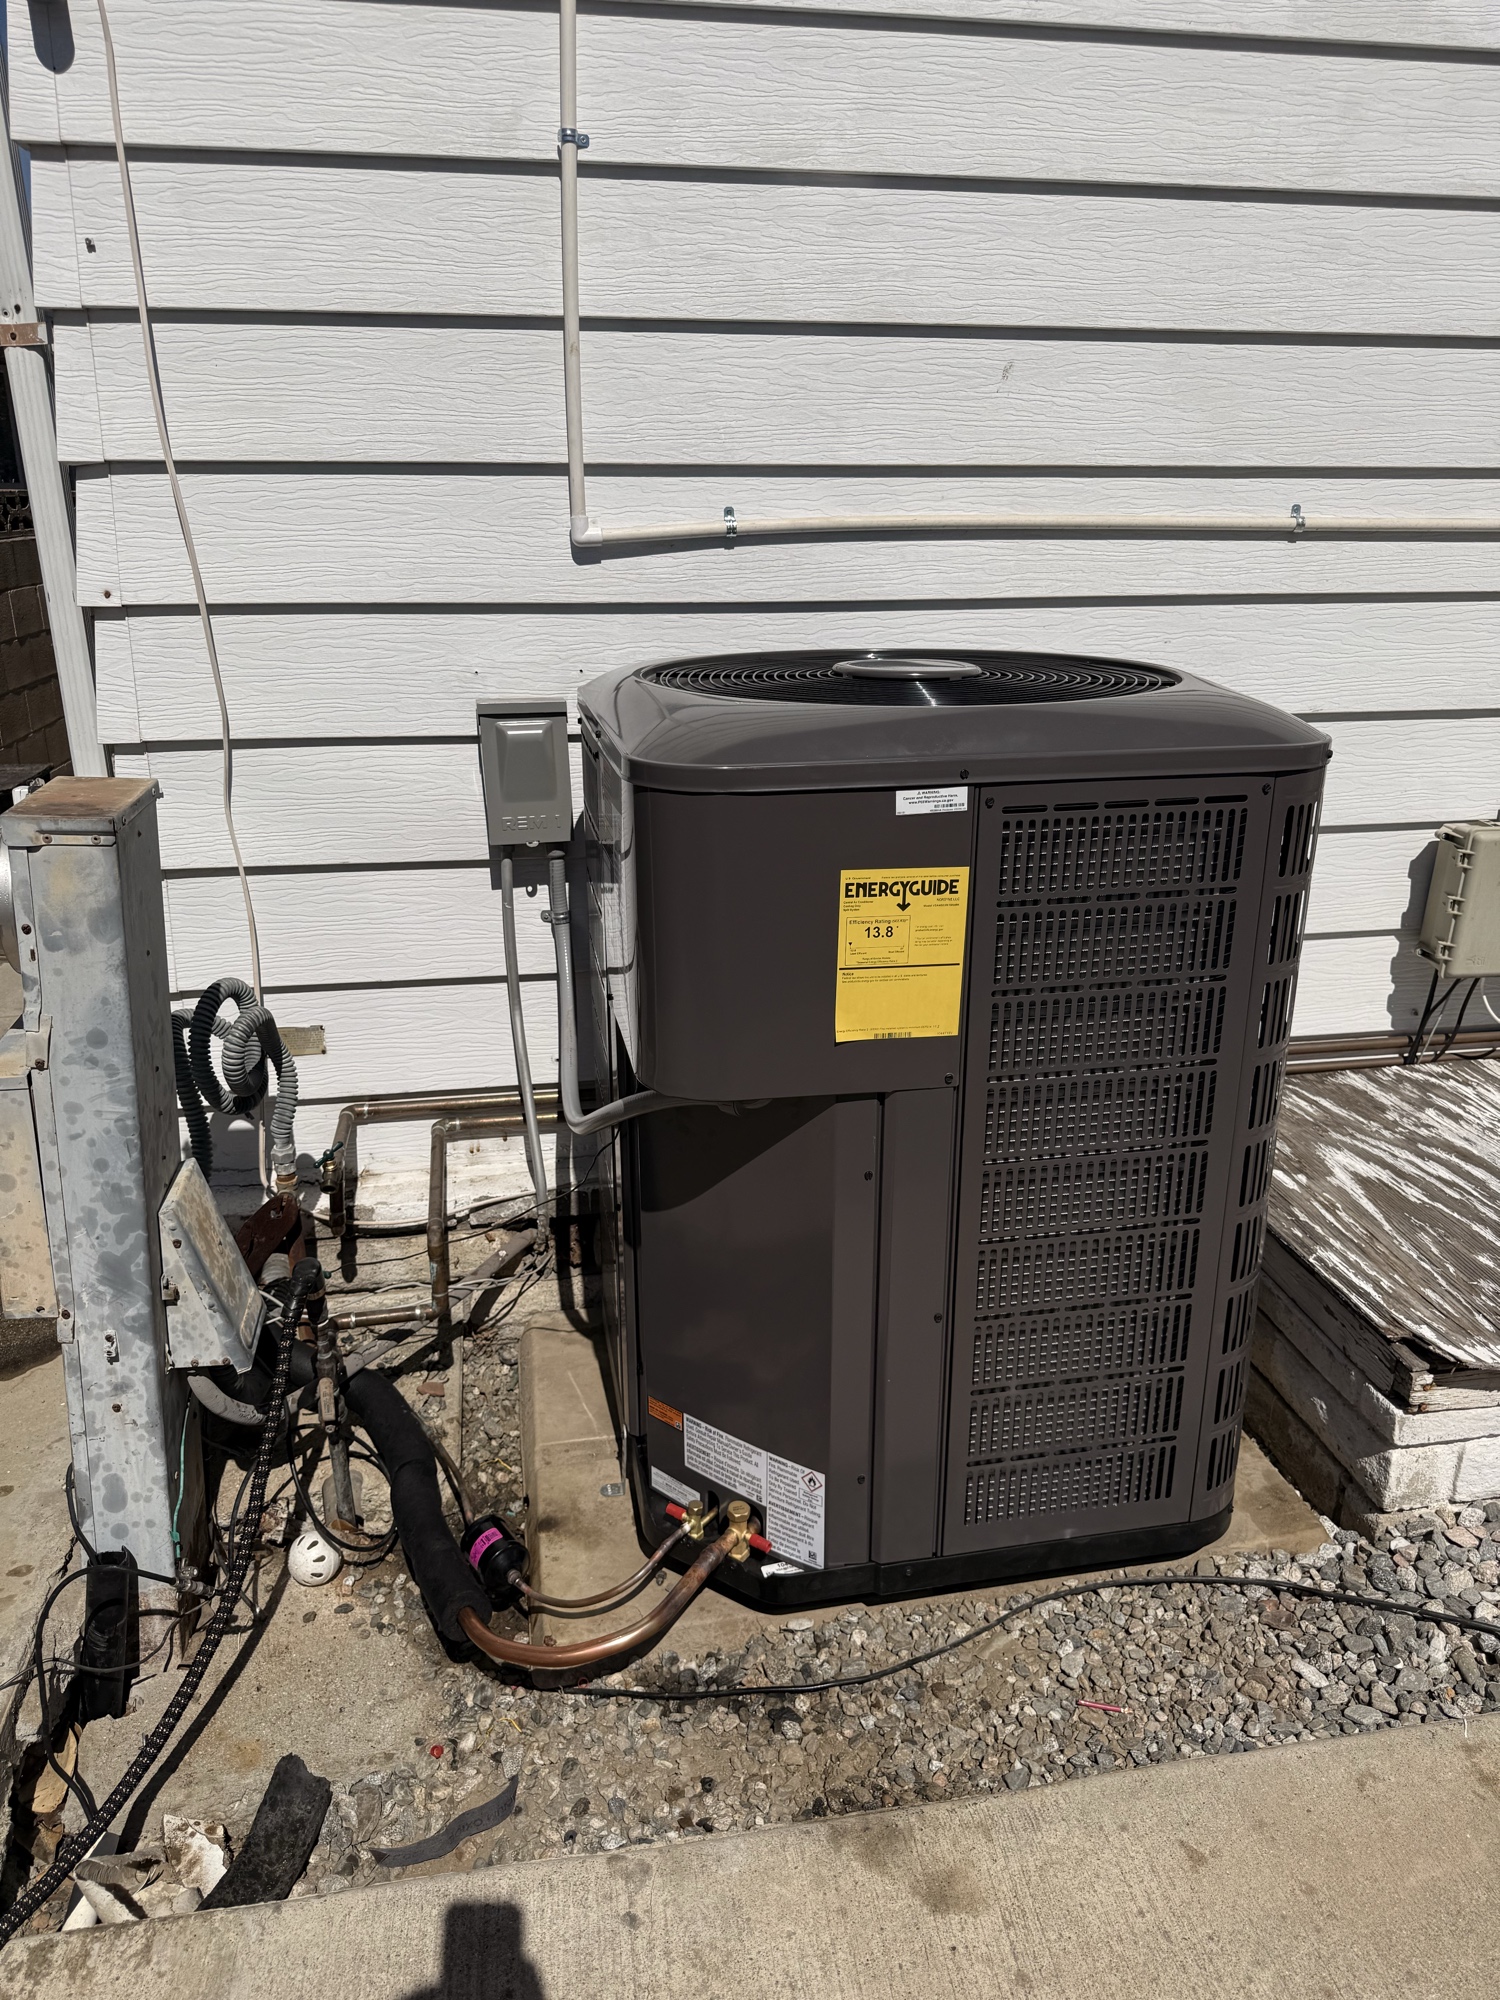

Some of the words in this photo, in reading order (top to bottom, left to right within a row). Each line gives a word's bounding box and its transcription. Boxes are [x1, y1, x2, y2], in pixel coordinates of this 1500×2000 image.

[845, 879, 960, 898] ENERGYGUIDE
[865, 926, 893, 938] 13.8
[769, 1456, 788, 1468] WARNING
[791, 1464, 799, 1472] Risk
[769, 1468, 788, 1481] Refrigerant
[777, 1465, 797, 1478] Flammable
[769, 1486, 781, 1496] Service
[784, 1486, 797, 1496] Trained
[769, 1492, 784, 1503] Puncture
[786, 1499, 806, 1513] Refrigerant
[769, 1500, 801, 1518] AVERTISSEMENT
